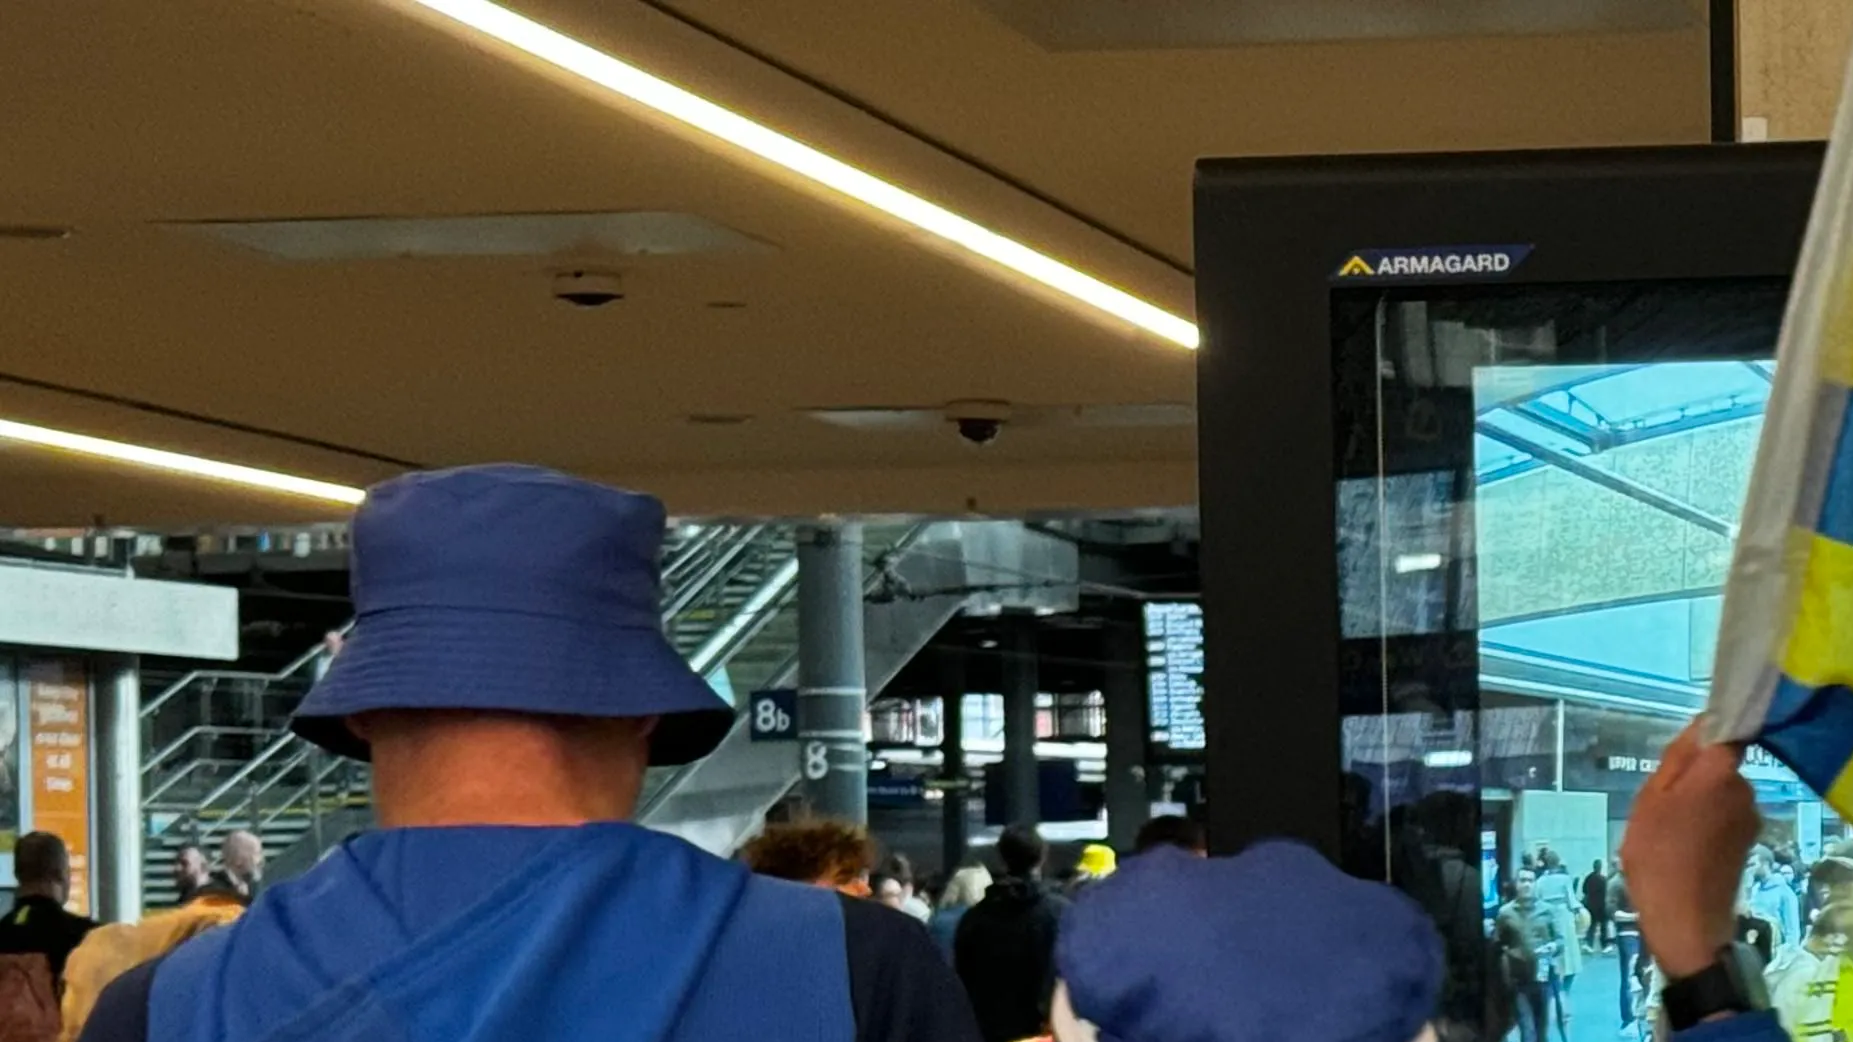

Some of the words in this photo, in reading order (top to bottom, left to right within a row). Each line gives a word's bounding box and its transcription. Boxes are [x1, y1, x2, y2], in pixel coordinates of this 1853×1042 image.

[1377, 253, 1510, 275] ARMAGARD
[756, 698, 791, 732] 8b
[806, 741, 829, 780] 8
